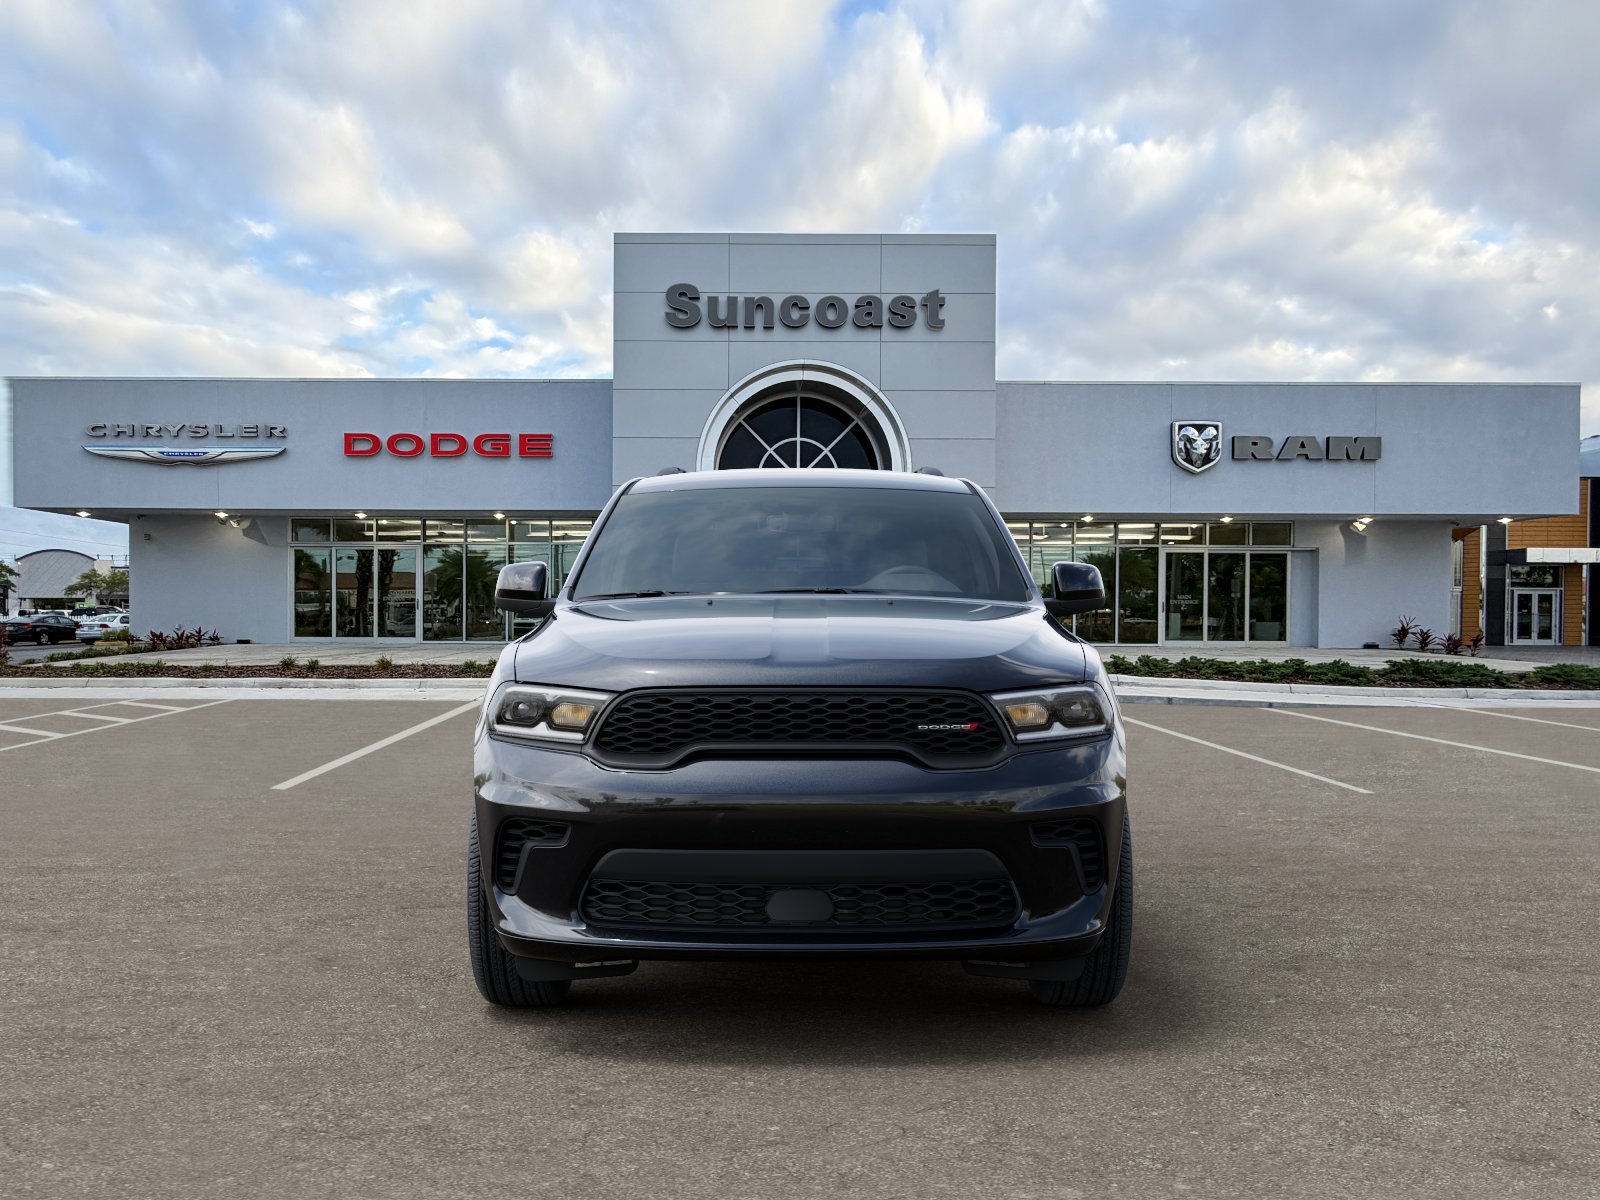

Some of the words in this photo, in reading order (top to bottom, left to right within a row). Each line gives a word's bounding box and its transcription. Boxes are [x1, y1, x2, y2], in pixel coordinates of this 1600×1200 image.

[664, 282, 946, 330] Suncoast
[85, 423, 287, 438] CHRYSLER
[343, 433, 553, 457] DODGE
[1231, 436, 1382, 460] RAM
